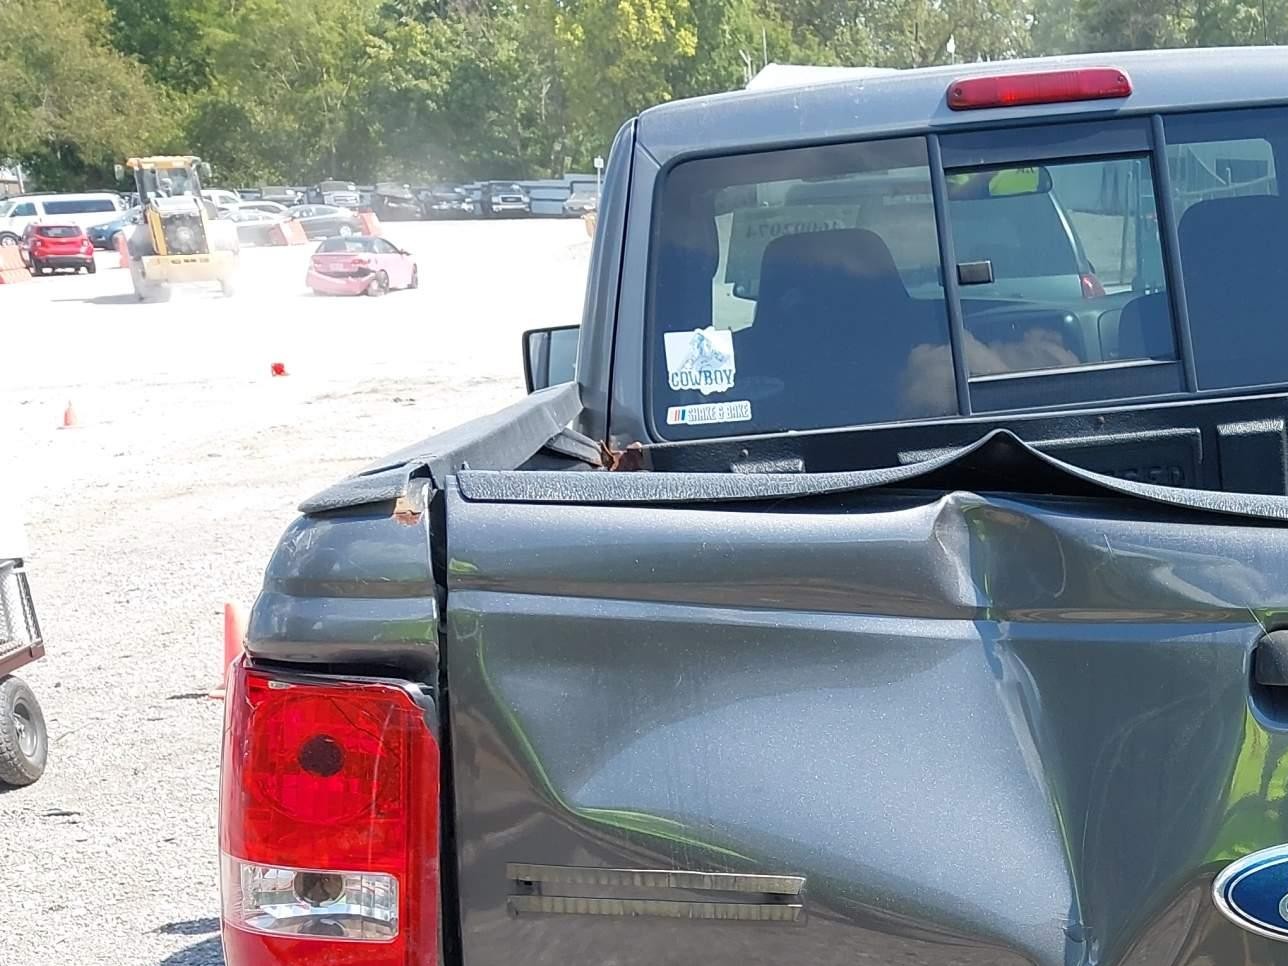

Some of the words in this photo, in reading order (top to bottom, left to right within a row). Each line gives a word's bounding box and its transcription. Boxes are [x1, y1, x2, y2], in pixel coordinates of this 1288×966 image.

[671, 369, 733, 387] COWBOY
[687, 406, 717, 422] SHAKE
[726, 403, 749, 420] BAKE
